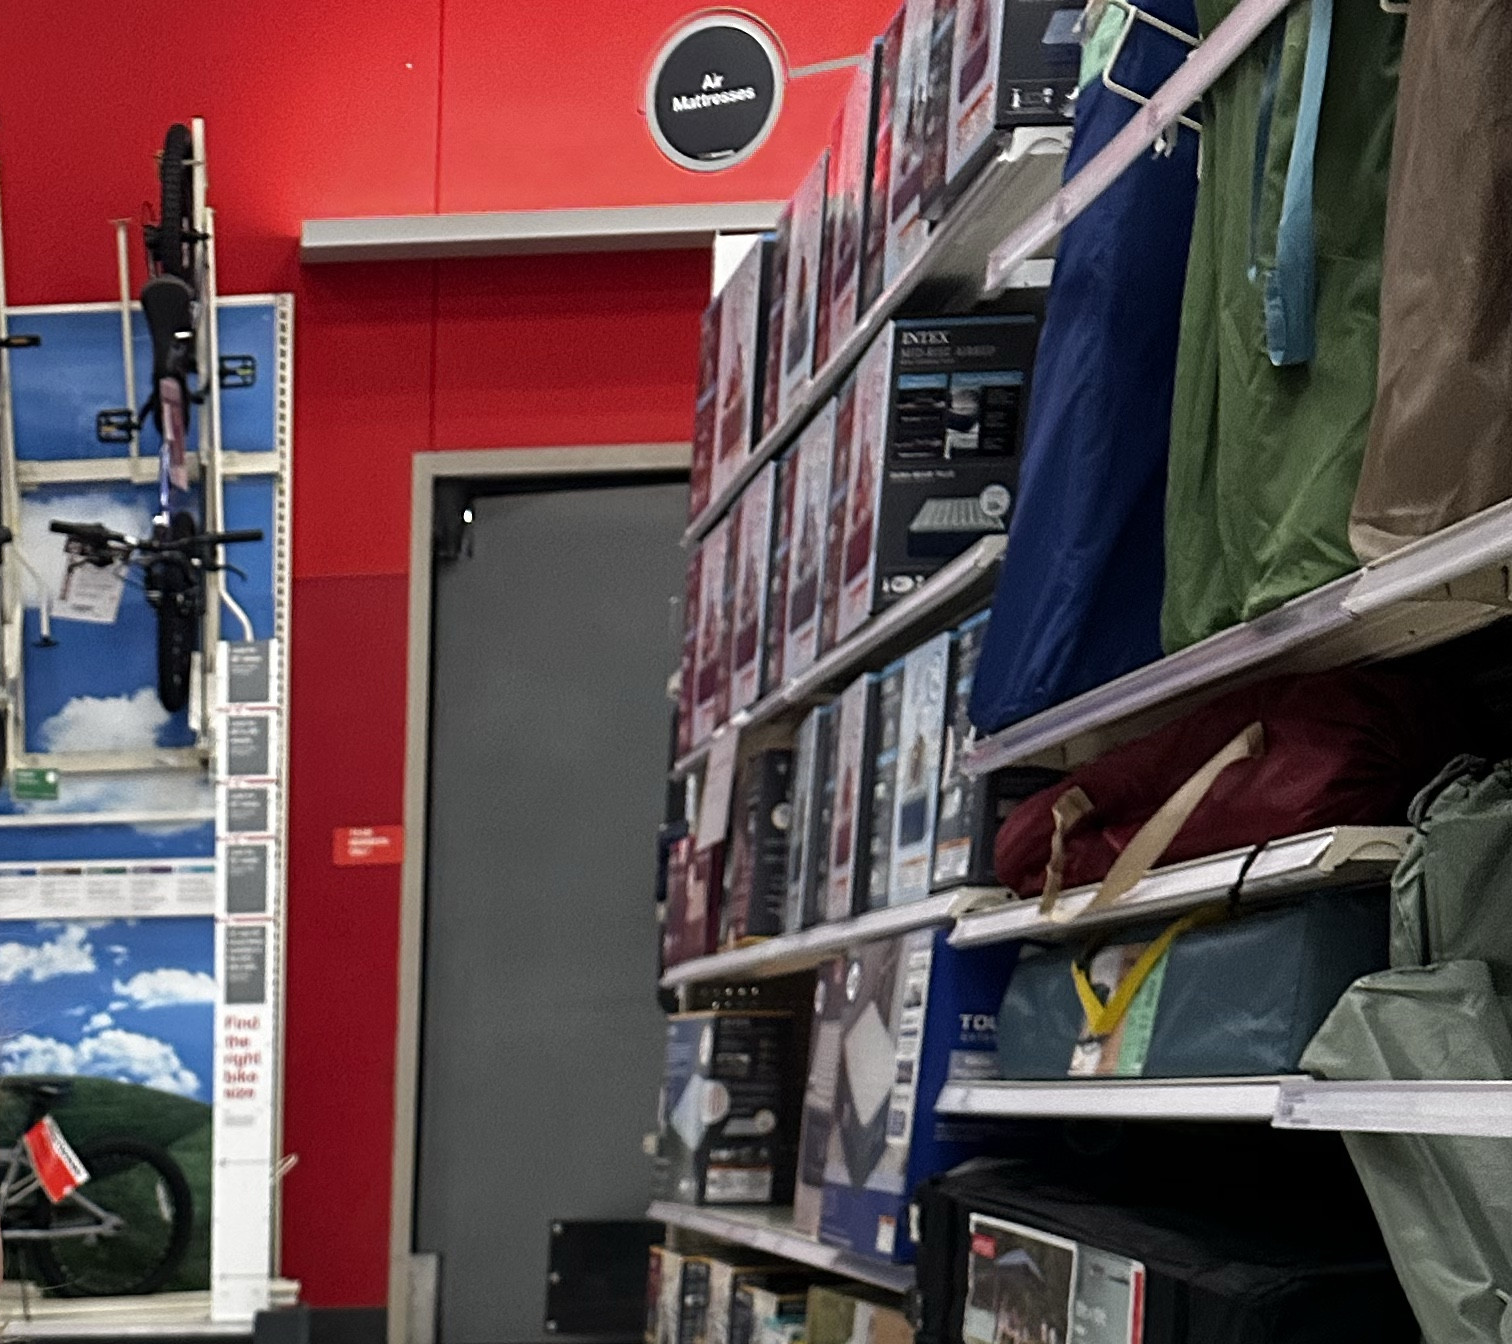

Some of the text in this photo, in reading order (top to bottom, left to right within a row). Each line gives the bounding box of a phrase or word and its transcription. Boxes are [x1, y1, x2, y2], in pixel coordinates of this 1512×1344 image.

[701, 72, 724, 91] Air
[672, 87, 756, 112] Mattresses
[902, 330, 950, 345] INTEX
